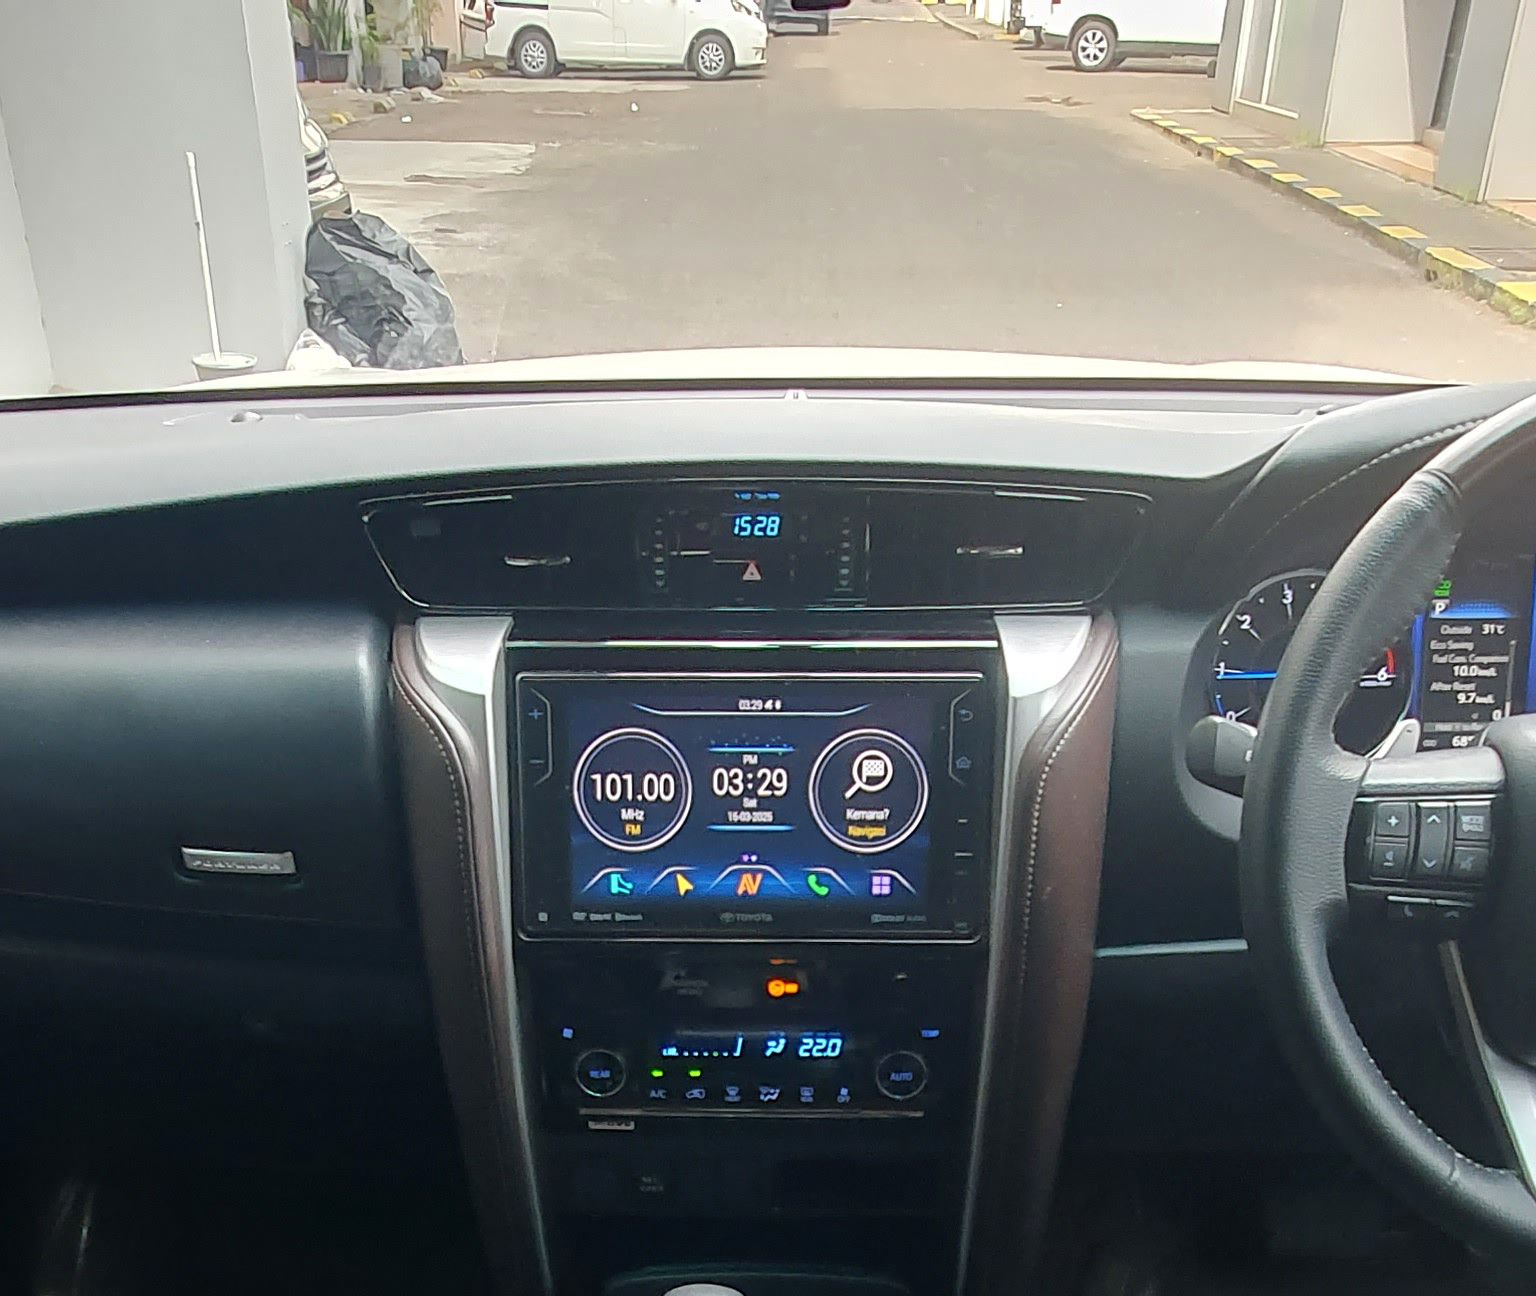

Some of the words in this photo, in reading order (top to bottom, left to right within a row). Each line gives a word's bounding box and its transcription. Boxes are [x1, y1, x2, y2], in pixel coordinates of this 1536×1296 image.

[1282, 589, 1293, 604] 3
[1435, 602, 1446, 615] P
[1240, 614, 1252, 630] 2
[1376, 665, 1388, 681] 6
[742, 754, 759, 765] PM
[590, 773, 675, 802] 101.00
[712, 767, 788, 797] 03:29
[620, 808, 645, 821] MHz
[625, 823, 642, 836] FM
[797, 1037, 843, 1058] 22.0
